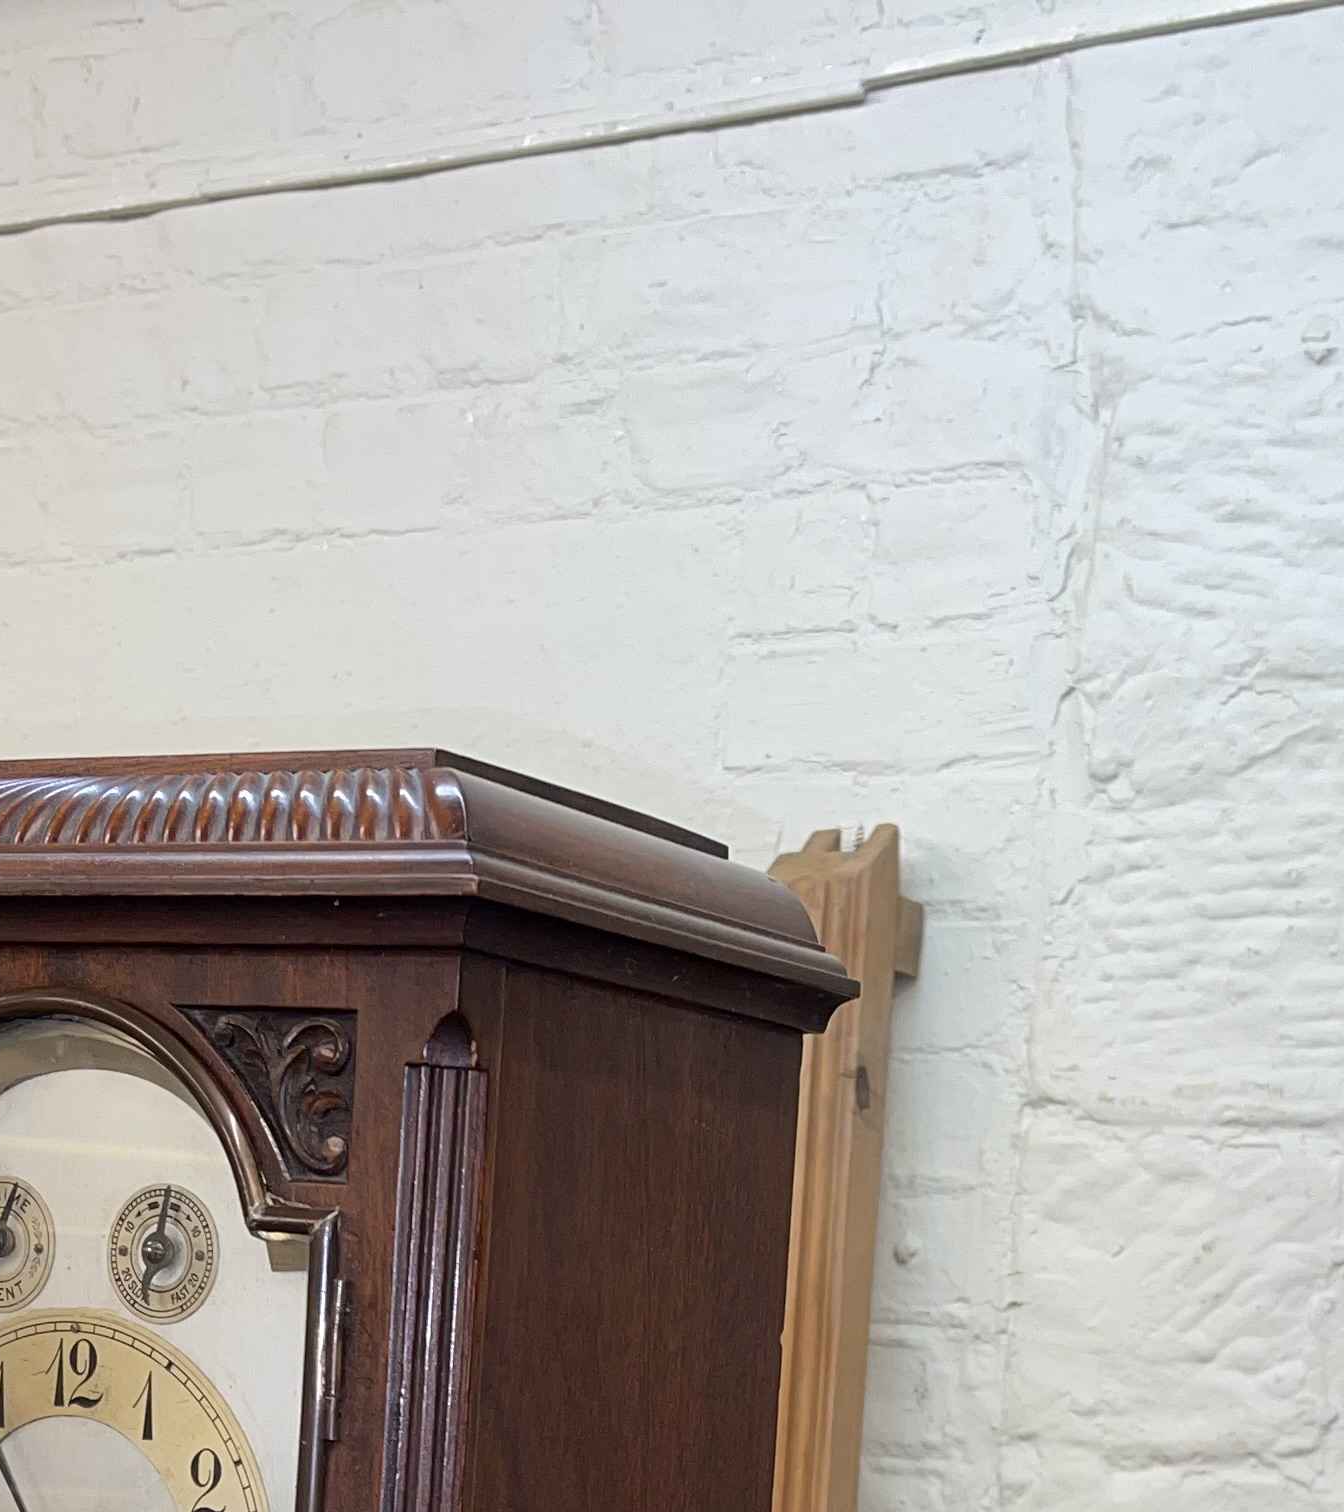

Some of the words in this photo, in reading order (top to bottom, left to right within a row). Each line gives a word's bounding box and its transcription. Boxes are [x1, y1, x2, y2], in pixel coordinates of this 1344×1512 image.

[124, 1220, 135, 1233] 10
[191, 1225, 202, 1239] 10
[121, 1267, 133, 1282] 20
[170, 1284, 190, 1304] FAST
[187, 1273, 200, 1288] 20
[44, 1339, 104, 1408] 12
[133, 1370, 154, 1441] 1
